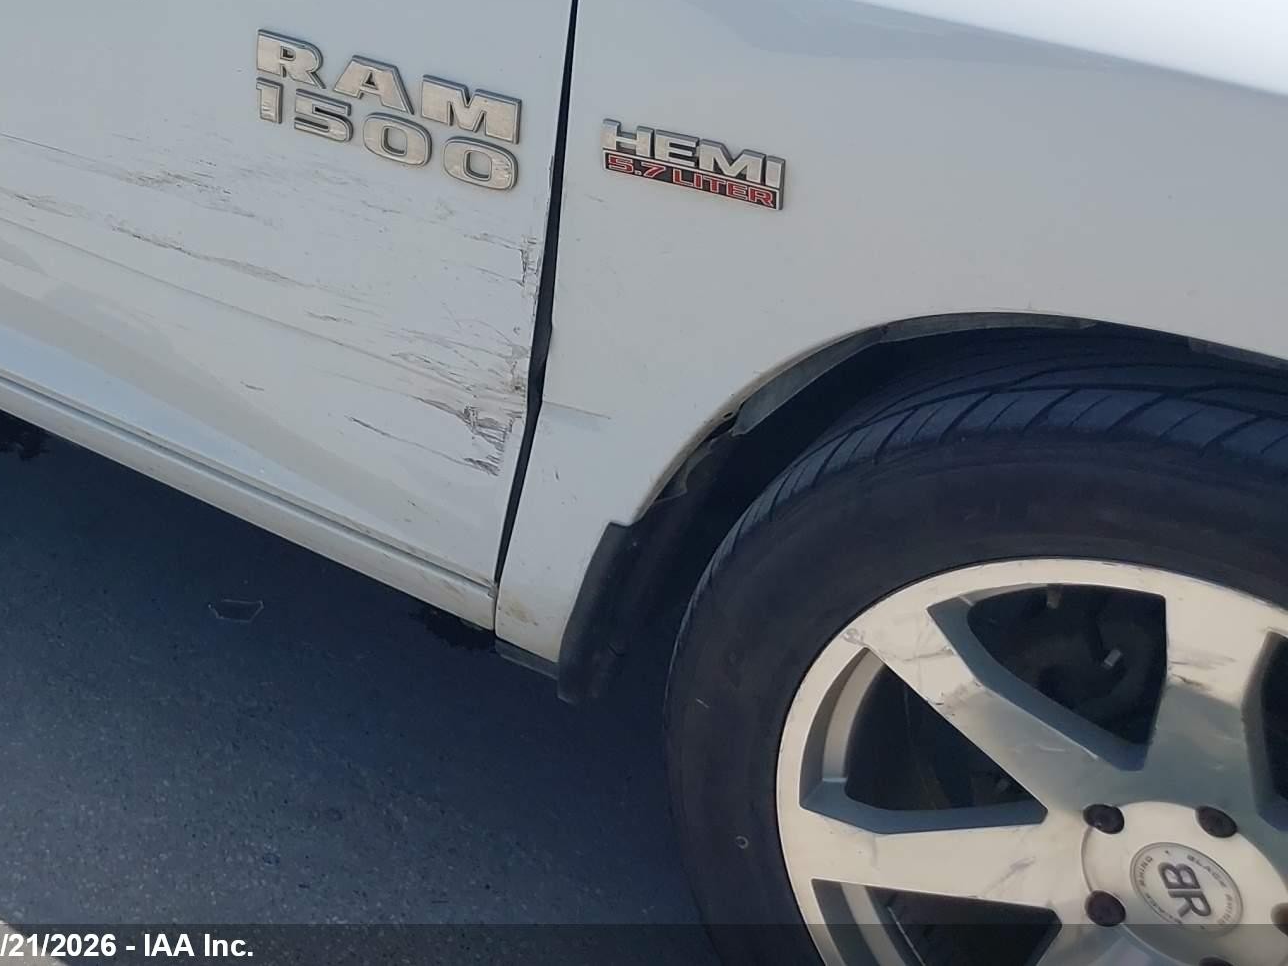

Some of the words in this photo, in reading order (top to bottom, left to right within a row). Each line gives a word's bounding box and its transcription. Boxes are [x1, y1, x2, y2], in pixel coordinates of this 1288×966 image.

[256, 29, 521, 144] RAM
[256, 77, 518, 190] 1500
[600, 118, 786, 188] HEMI
[608, 154, 666, 178] 5.7
[673, 169, 774, 207] LITER
